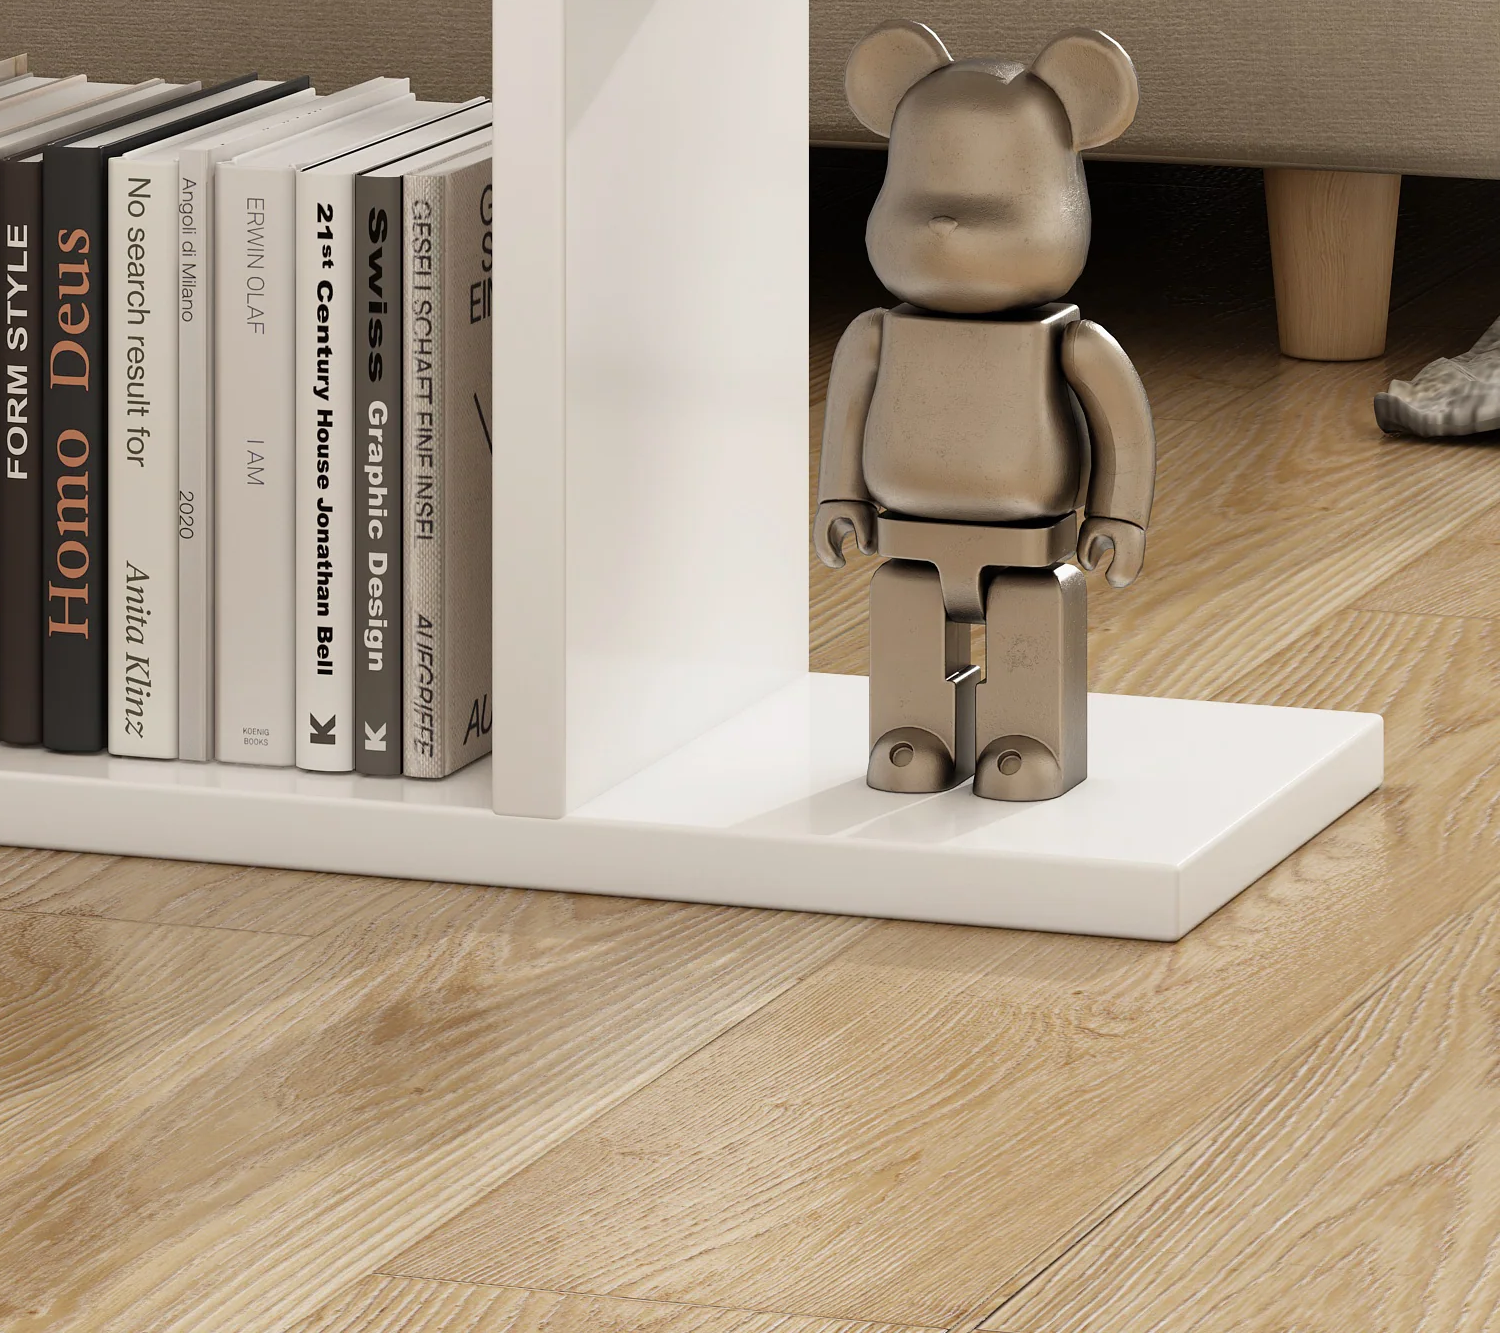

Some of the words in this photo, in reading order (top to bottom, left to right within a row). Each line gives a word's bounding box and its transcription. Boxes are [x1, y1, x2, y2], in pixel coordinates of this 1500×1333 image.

[128, 178, 151, 217] No
[178, 177, 197, 235] Angoli
[317, 203, 334, 268] 21st
[7, 225, 27, 351] STYLE
[127, 227, 150, 324] search
[182, 241, 196, 256] di
[50, 229, 89, 391] Deus
[182, 264, 196, 322] Milano
[369, 208, 387, 382] Swiss
[127, 336, 150, 416] result
[313, 280, 333, 401] Century
[7, 365, 27, 479] FORM
[127, 427, 150, 467] for
[317, 410, 333, 489] House
[364, 401, 387, 539] Graphic
[49, 430, 89, 639] Homo
[178, 490, 194, 540] 2020
[317, 498, 333, 616] Jonathan
[126, 560, 151, 644] Anita
[364, 552, 387, 670] Design
[317, 627, 333, 675] Bell
[125, 652, 151, 738] Klinz
[243, 728, 269, 736] KOENIG
[244, 738, 268, 746] BOOKS
